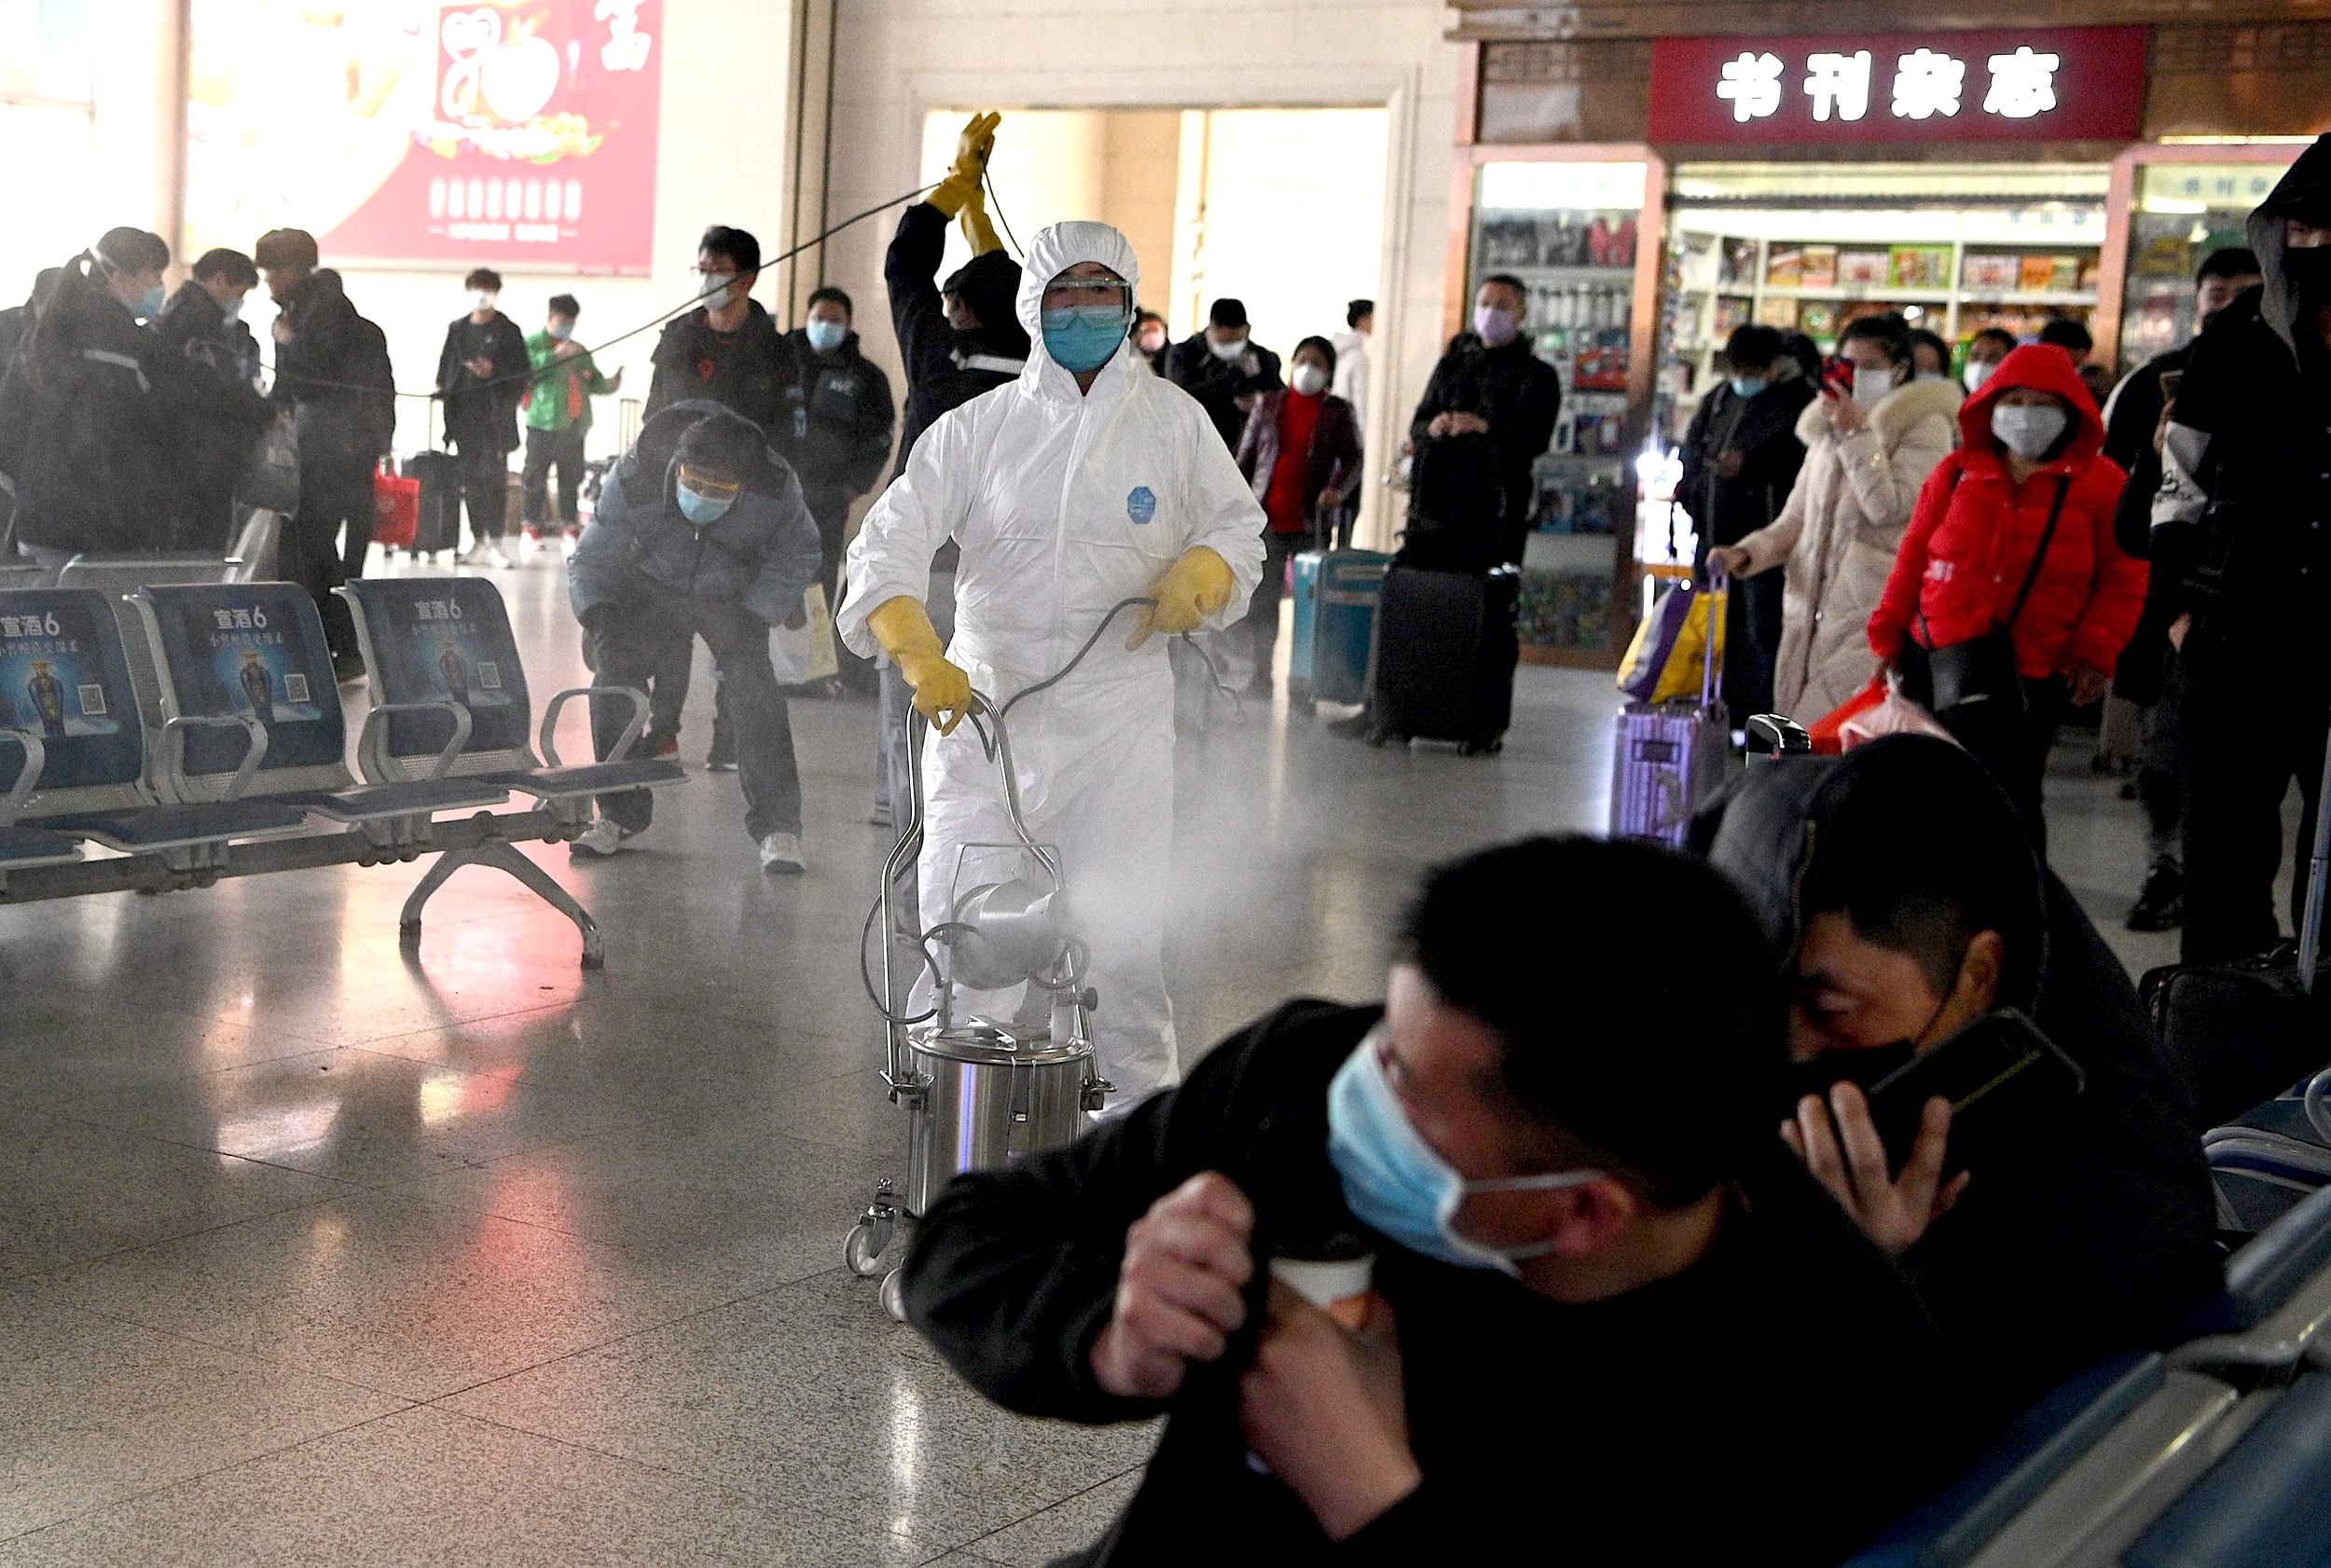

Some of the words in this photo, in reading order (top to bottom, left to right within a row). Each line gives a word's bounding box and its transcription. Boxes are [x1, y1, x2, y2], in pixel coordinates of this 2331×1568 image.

[1716, 46, 2061, 122] 书刊杂志
[0, 612, 61, 637] 宣酒6
[214, 604, 268, 629] 宣酒6
